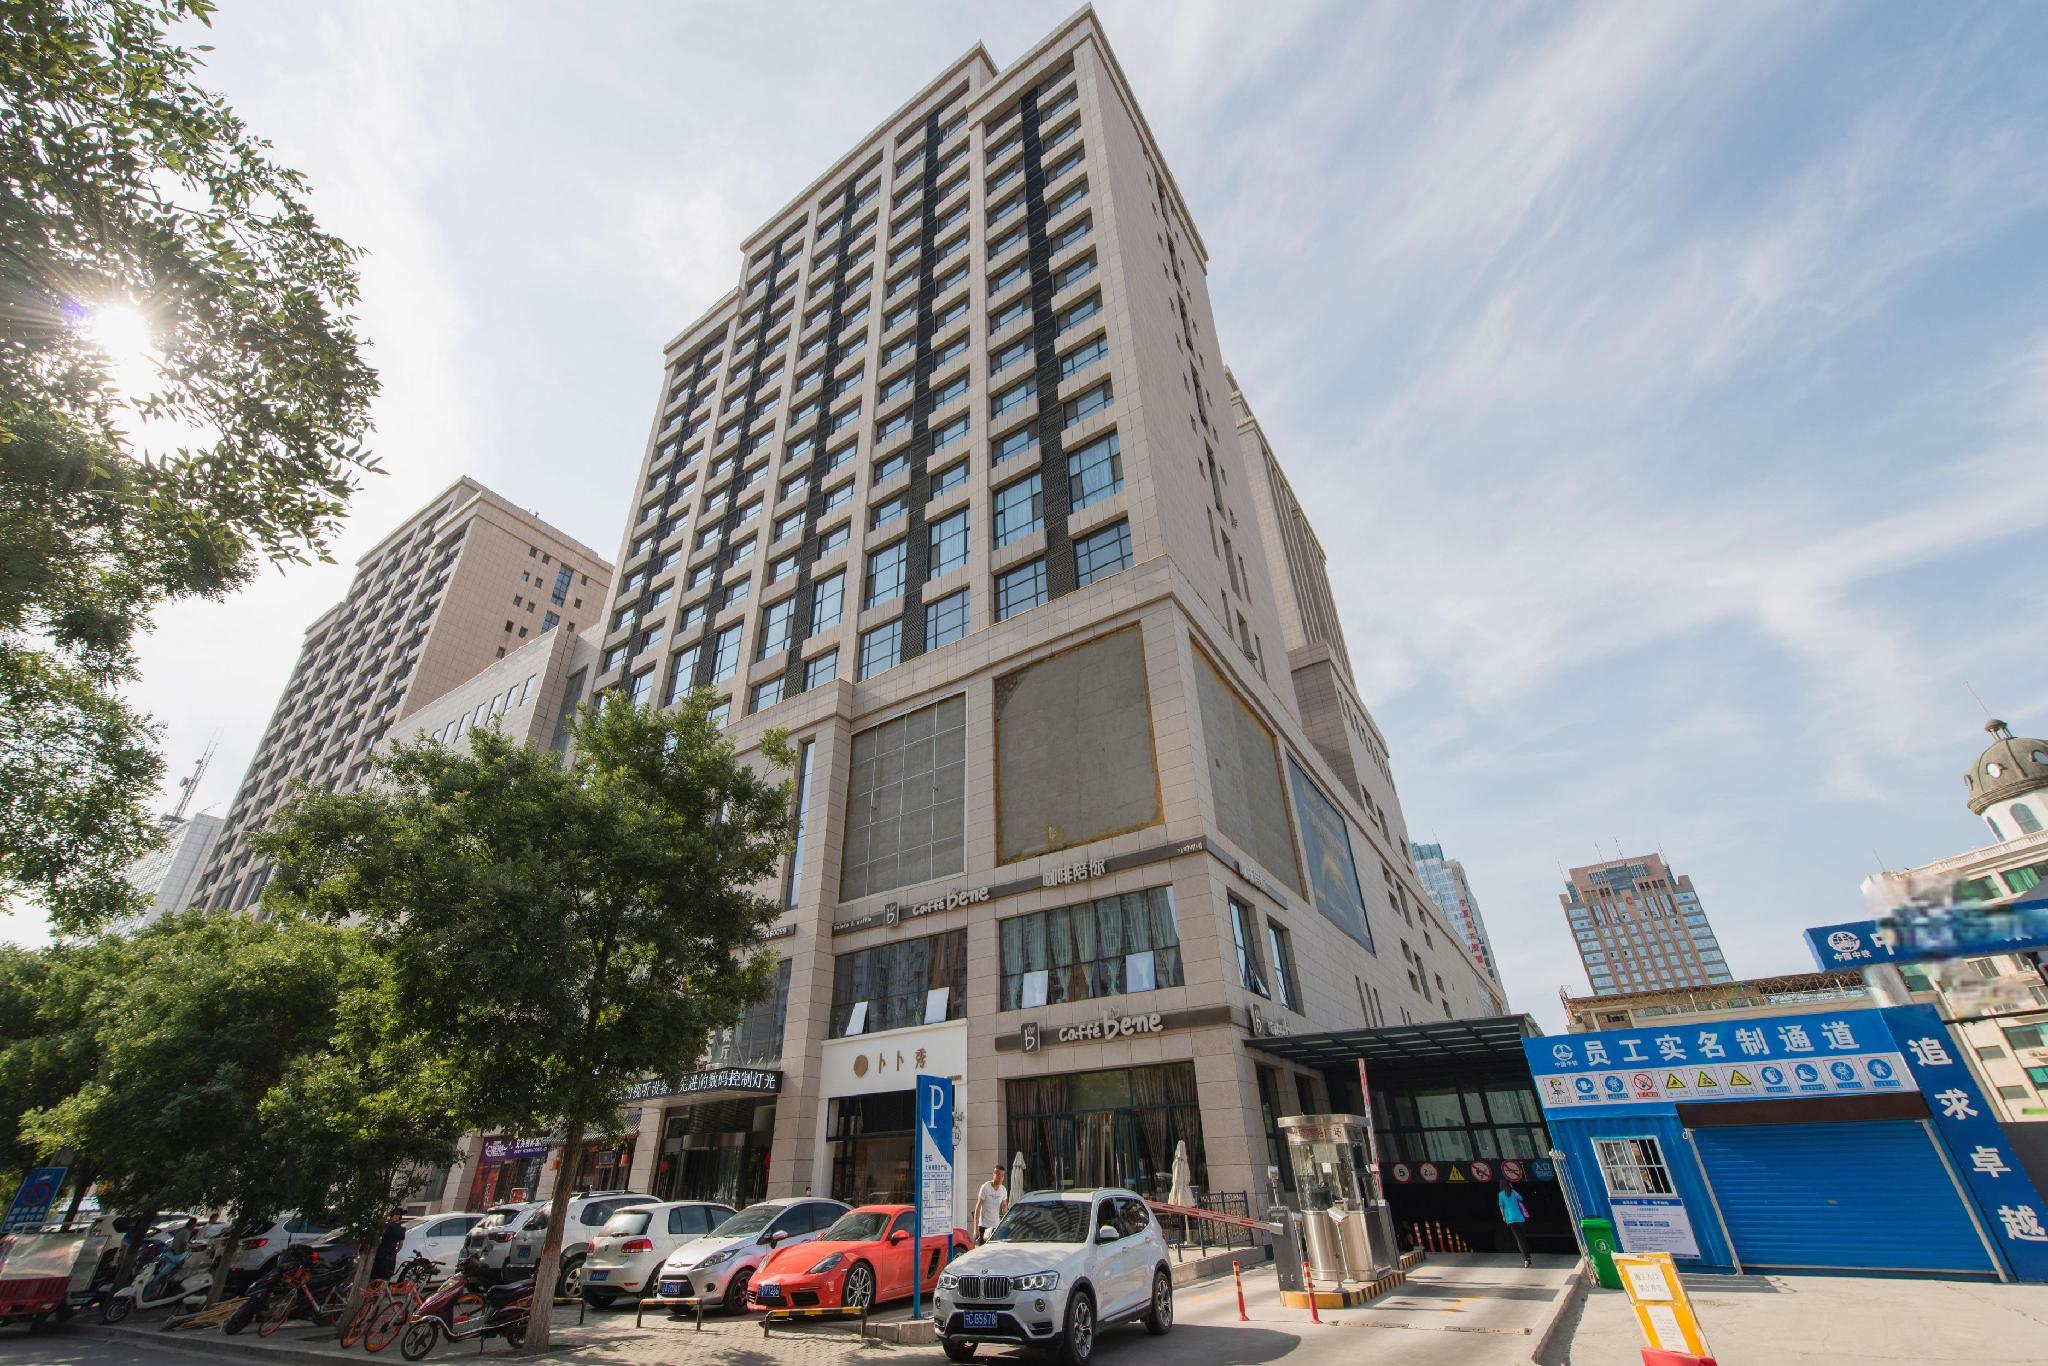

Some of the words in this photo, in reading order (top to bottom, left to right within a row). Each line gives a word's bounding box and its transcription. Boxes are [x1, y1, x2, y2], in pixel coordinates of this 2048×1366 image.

[1042, 859, 1106, 887] 咖啡陪你
[1833, 949, 1872, 962] 中国中铁
[1103, 1009, 1164, 1040] bene
[1584, 1021, 1860, 1067] 员工实名制通道
[878, 1048, 927, 1074] 卜卜秀
[928, 1084, 944, 1129] P
[1907, 1037, 2048, 1241] 追求卓越
[1398, 1168, 1406, 1177] 5
